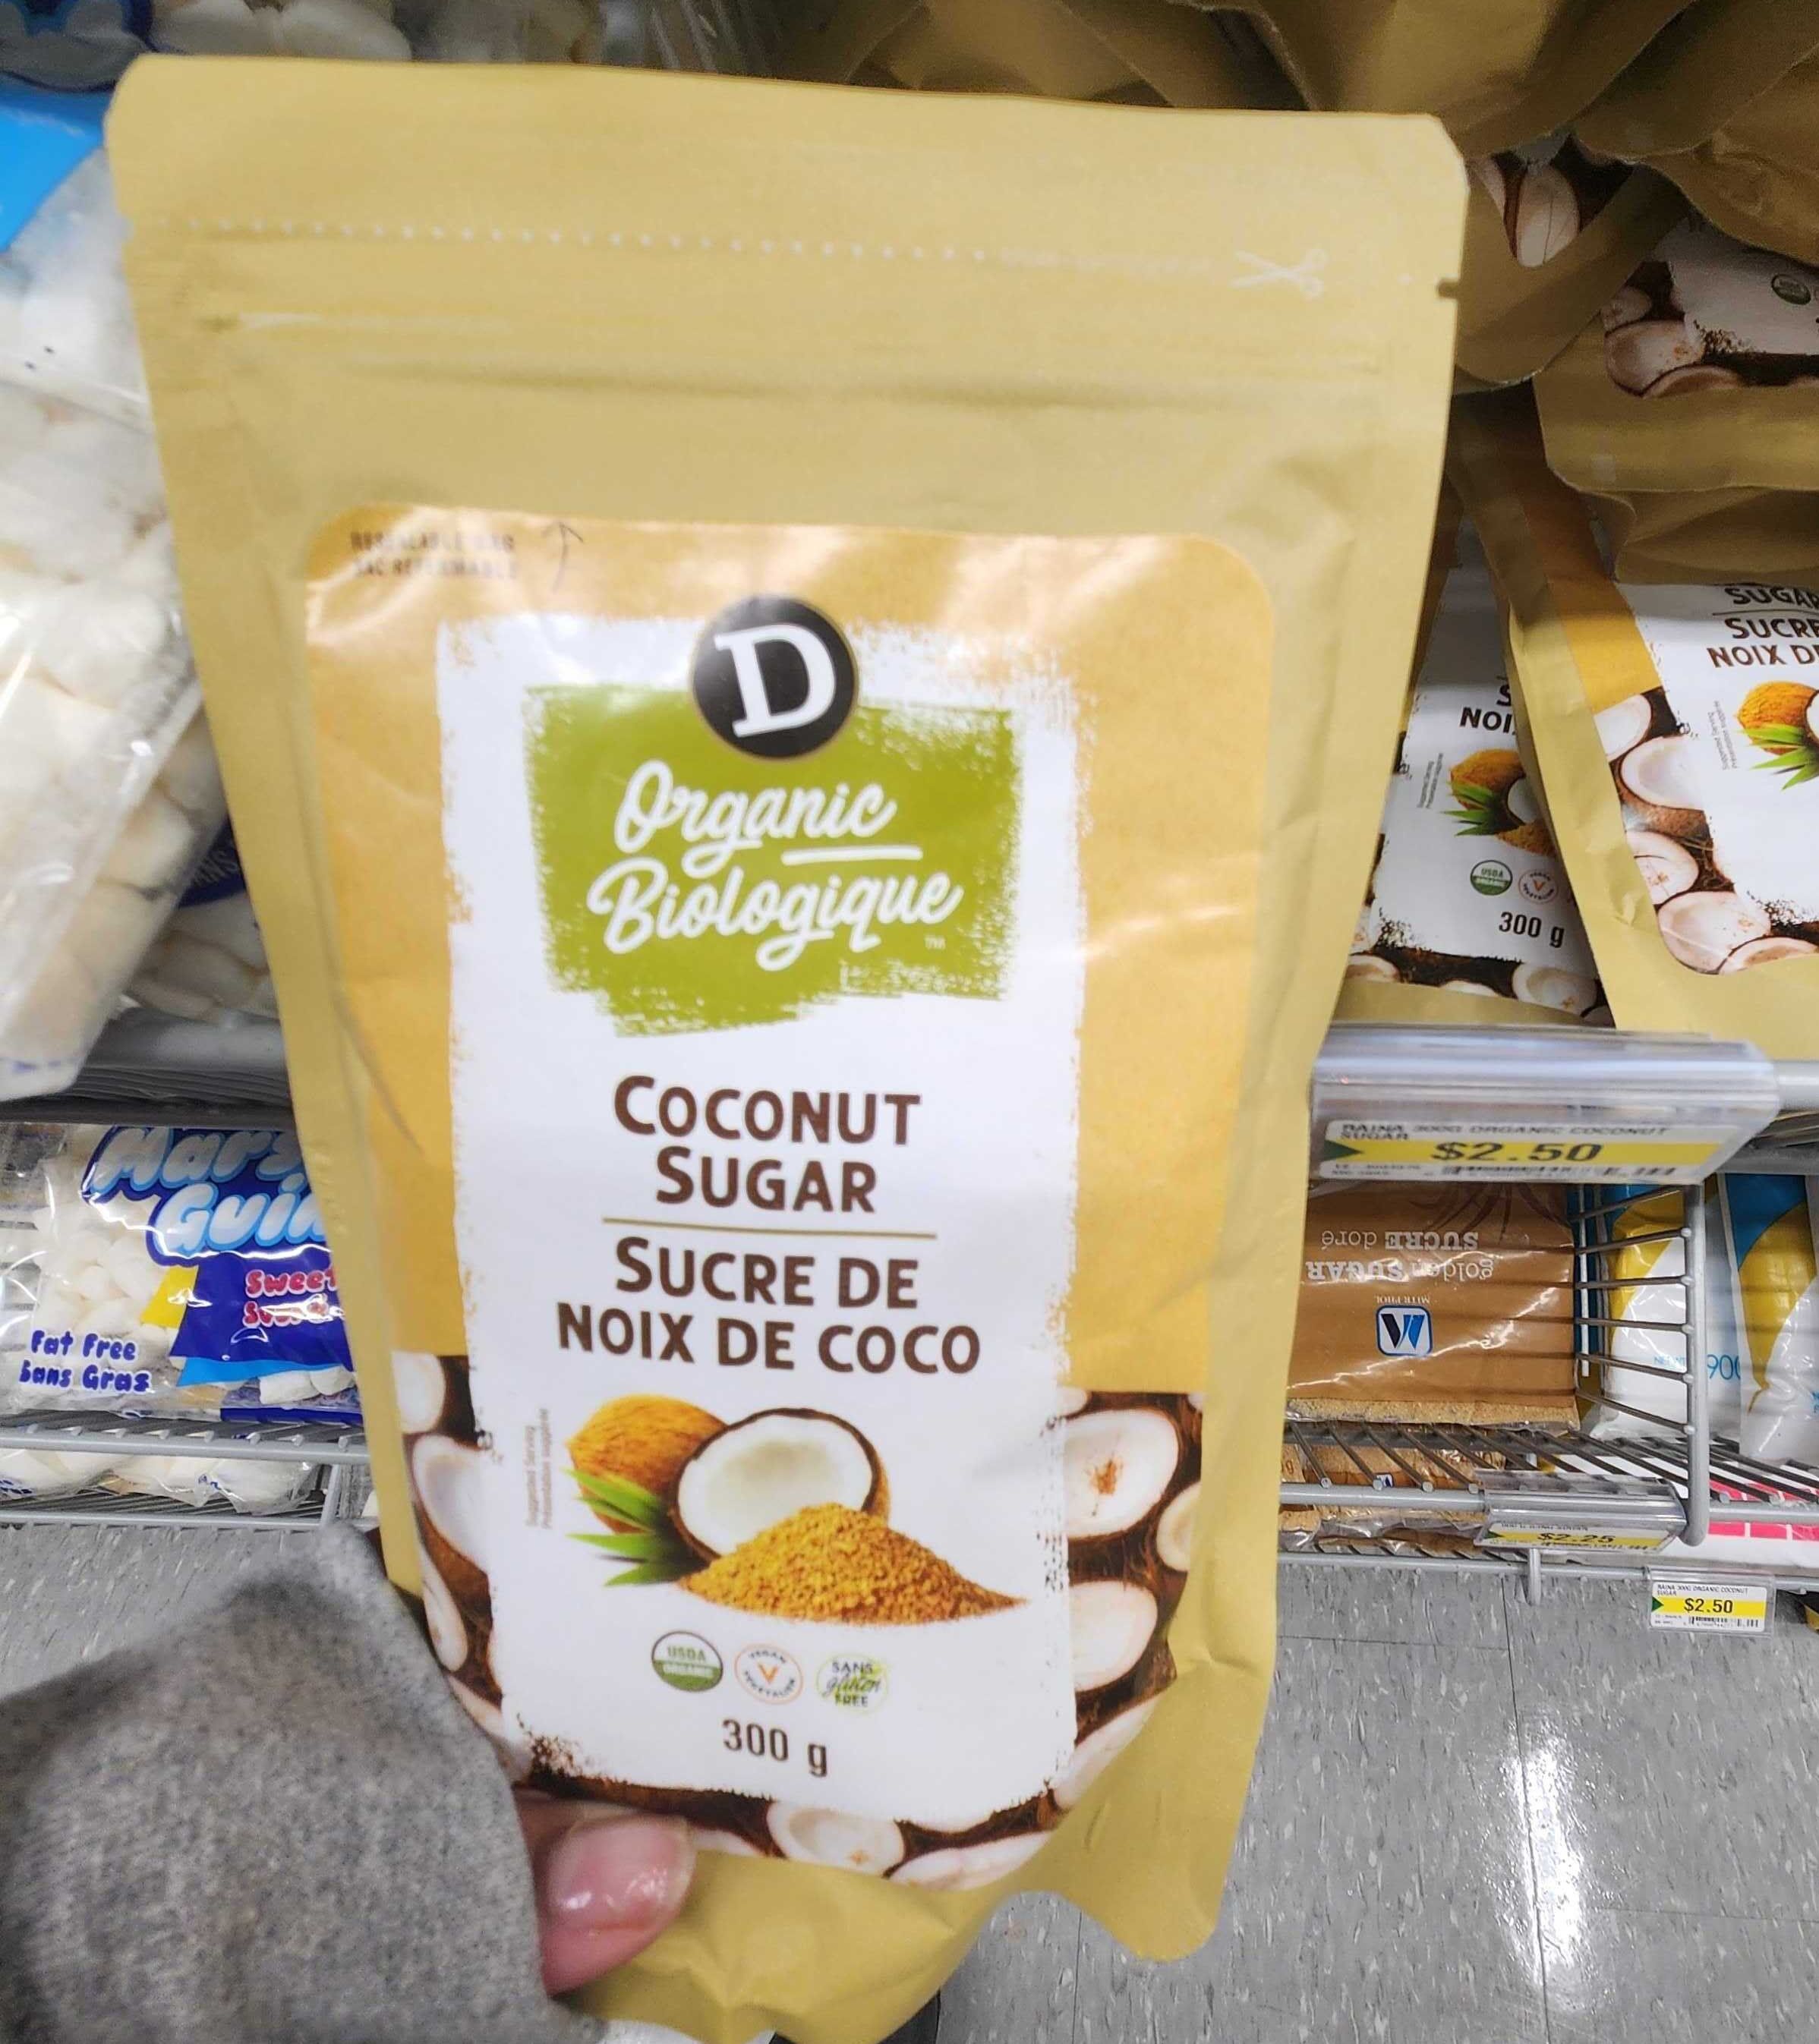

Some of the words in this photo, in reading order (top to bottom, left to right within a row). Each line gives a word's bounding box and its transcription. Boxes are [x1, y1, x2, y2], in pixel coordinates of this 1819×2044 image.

[1707, 645, 1787, 668] NOIX
[715, 623, 835, 737] D
[1460, 707, 1515, 735] NOI
[614, 760, 897, 878] Organic
[587, 857, 963, 971] Biologique
[1499, 912, 1542, 937] 300
[1549, 926, 1564, 948] g
[613, 1076, 920, 1145] COCONUT
[1430, 1142, 1604, 1161] $2.50
[656, 1146, 875, 1213] SUGAR
[1322, 1230, 1377, 1250] doré
[1385, 1231, 1478, 1250] SUCRE
[616, 1236, 815, 1305] SUCRE
[838, 1258, 919, 1309] DE
[1306, 1261, 1403, 1280] SUGAR
[31, 1330, 74, 1356] Fat
[82, 1333, 136, 1361] Free
[557, 1302, 695, 1364] NOIX
[717, 1317, 794, 1369] DE
[818, 1325, 980, 1373] COCO
[1537, 1532, 1616, 1543] $2.25
[1684, 1598, 1733, 1614] $2.50
[667, 1646, 707, 1662] USDA
[832, 1661, 873, 1674] SANS
[834, 1694, 869, 1708] FREE
[722, 1719, 789, 1762] 300
[809, 1743, 828, 1777] g
